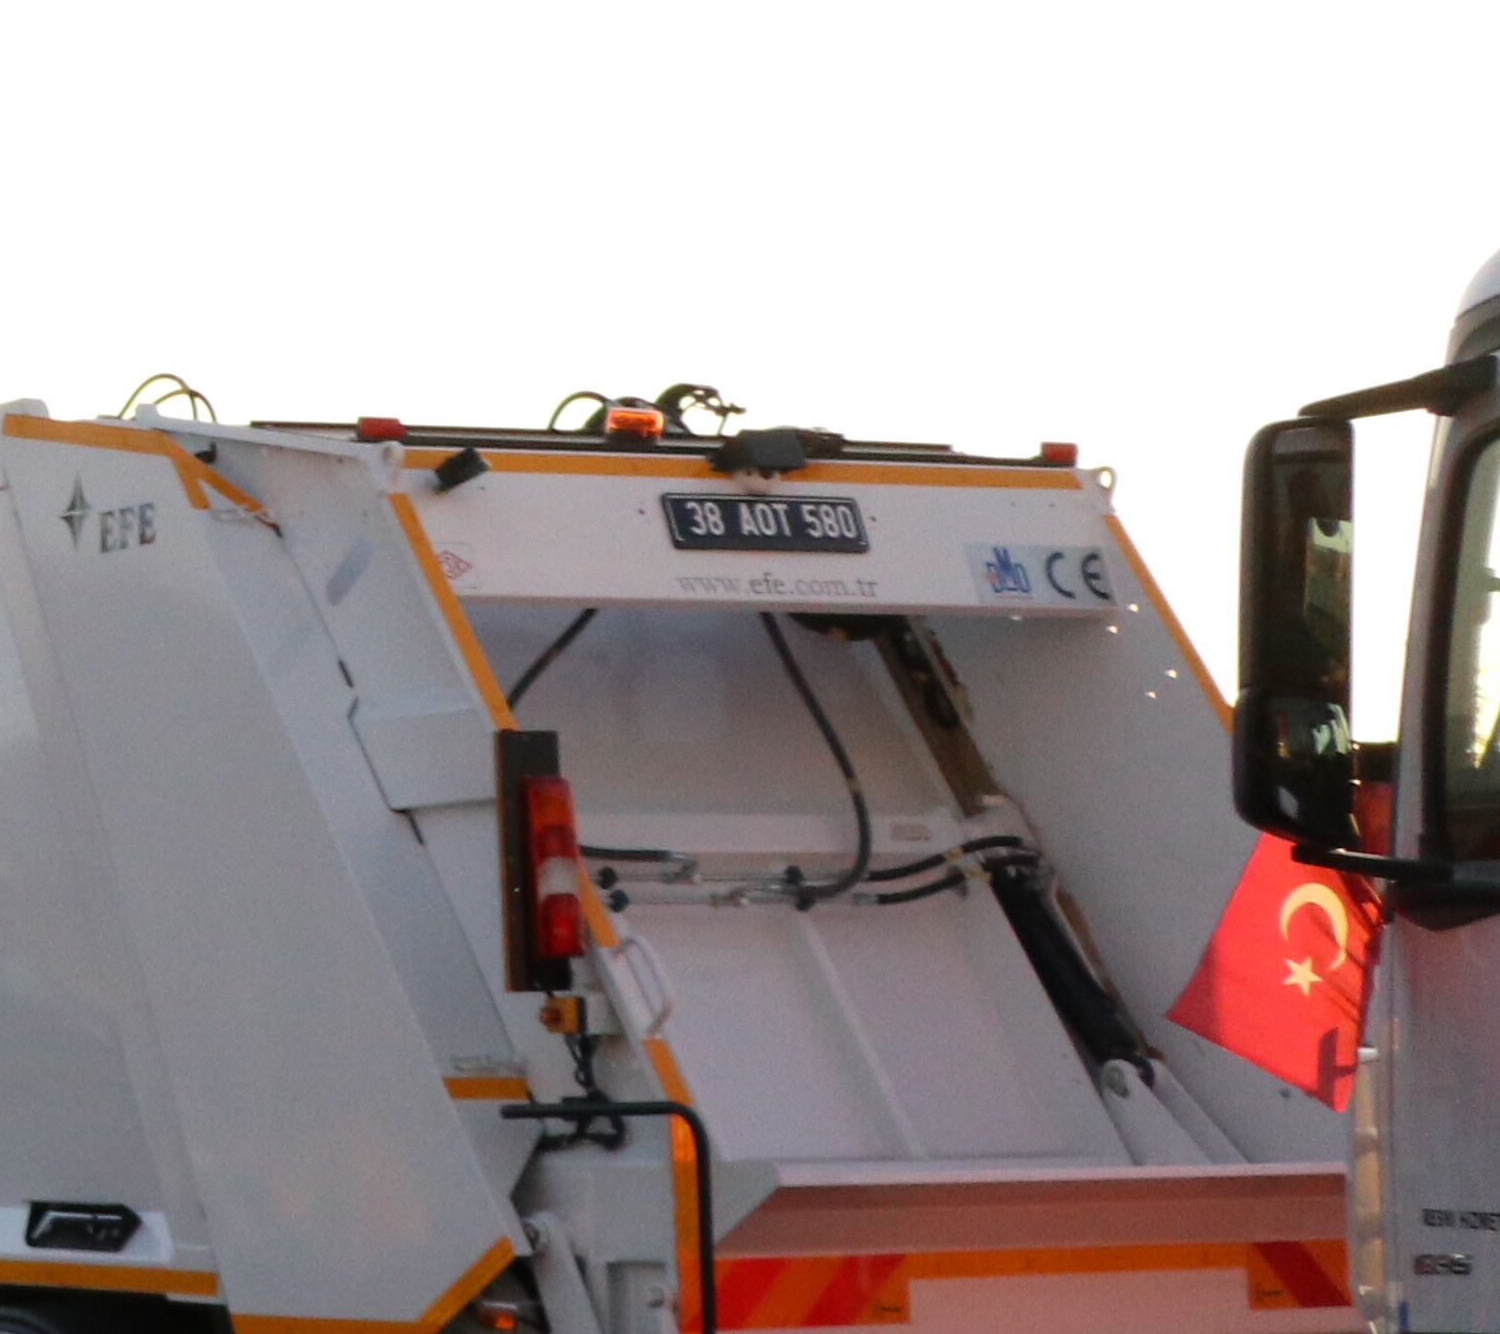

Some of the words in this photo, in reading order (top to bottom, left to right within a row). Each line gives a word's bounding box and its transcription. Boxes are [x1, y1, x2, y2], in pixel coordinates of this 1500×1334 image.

[99, 501, 156, 554] EFE
[685, 502, 725, 536] 38
[739, 503, 791, 537] AOT
[802, 505, 855, 538] 580
[678, 572, 879, 598] www.efe.com.tr
